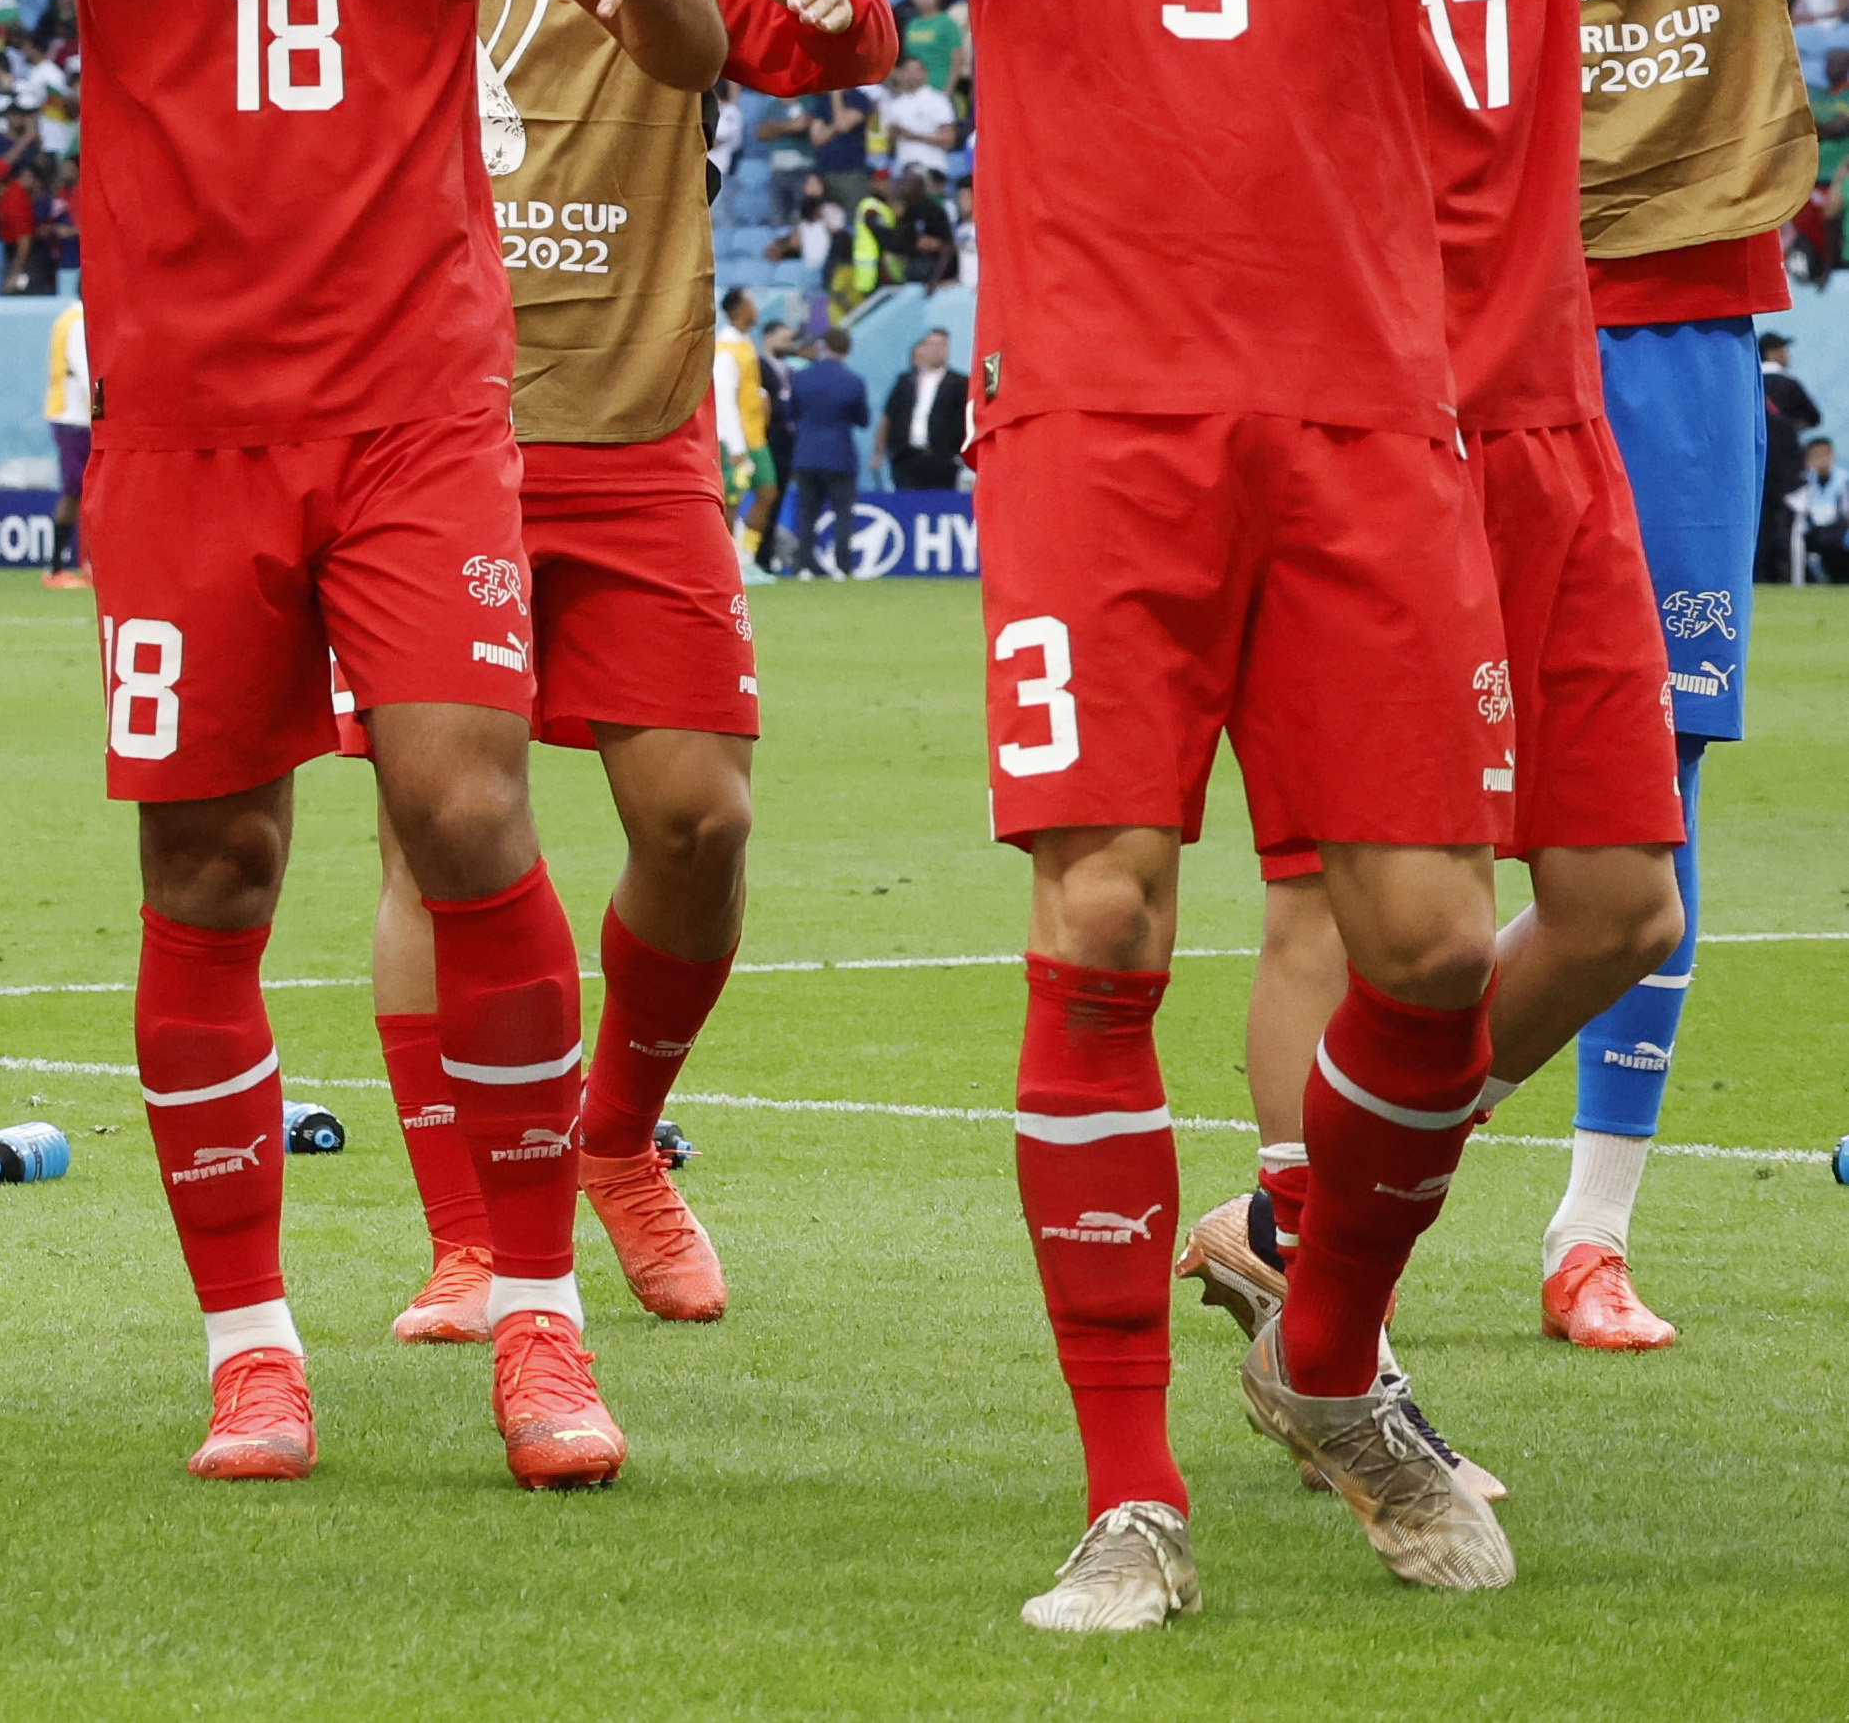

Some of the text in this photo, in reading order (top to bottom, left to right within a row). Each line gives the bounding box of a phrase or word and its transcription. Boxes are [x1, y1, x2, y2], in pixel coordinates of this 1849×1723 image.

[1579, 3, 1721, 55] RLD CUP
[1581, 44, 1710, 95] r2022
[494, 201, 628, 234] RLD CUP
[472, 641, 524, 674] PUMA
[102, 614, 184, 762] 8
[993, 614, 1081, 778] 3
[1604, 1048, 1667, 1071] PUMA
[403, 1112, 456, 1131] PUMA
[491, 1144, 563, 1163] PUMA
[171, 1156, 244, 1186] PUMA
[1042, 1225, 1134, 1245] PUMA
